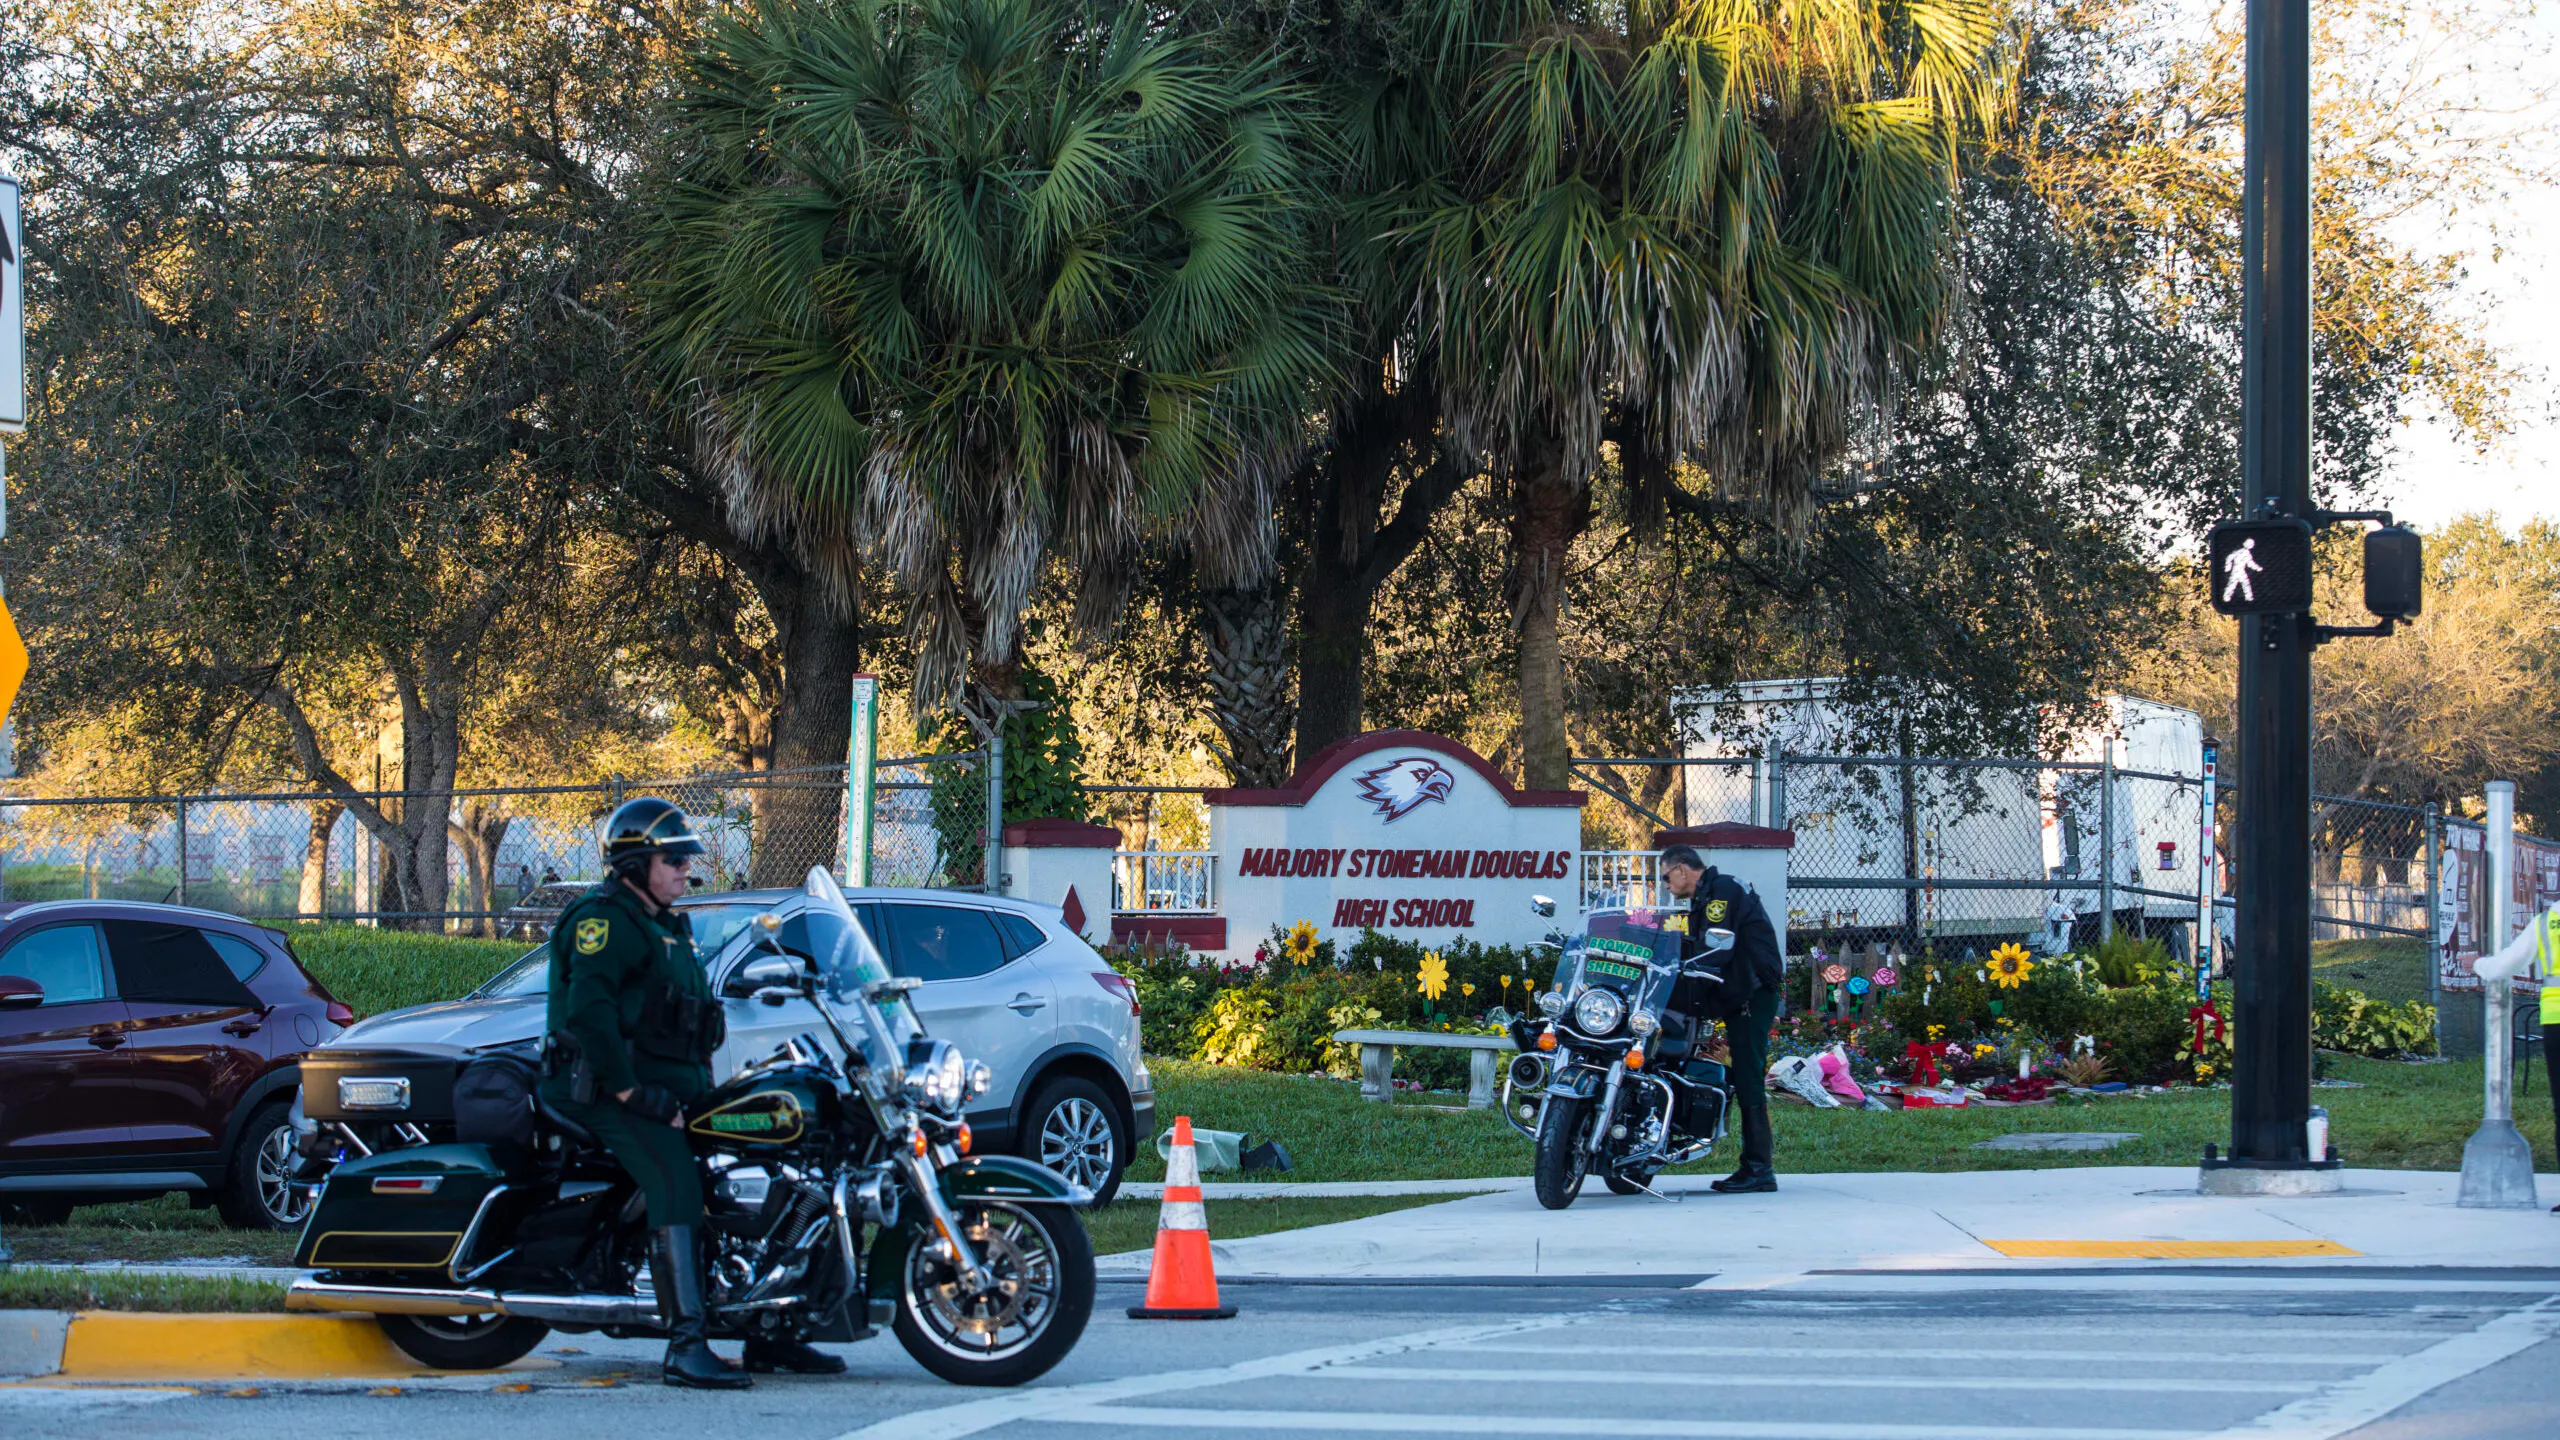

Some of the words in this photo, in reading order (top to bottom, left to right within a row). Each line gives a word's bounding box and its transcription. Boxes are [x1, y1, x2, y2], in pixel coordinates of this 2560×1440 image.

[1239, 848, 1346, 878] MARJORY
[1347, 848, 1470, 879] STONEMAN
[1469, 850, 1571, 879] DOUGLAS
[1332, 899, 1388, 928] HIGH
[1389, 898, 1475, 928] SCHOOL
[1589, 937, 1653, 959] BROWARD
[1586, 960, 1641, 980] SHERIFF
